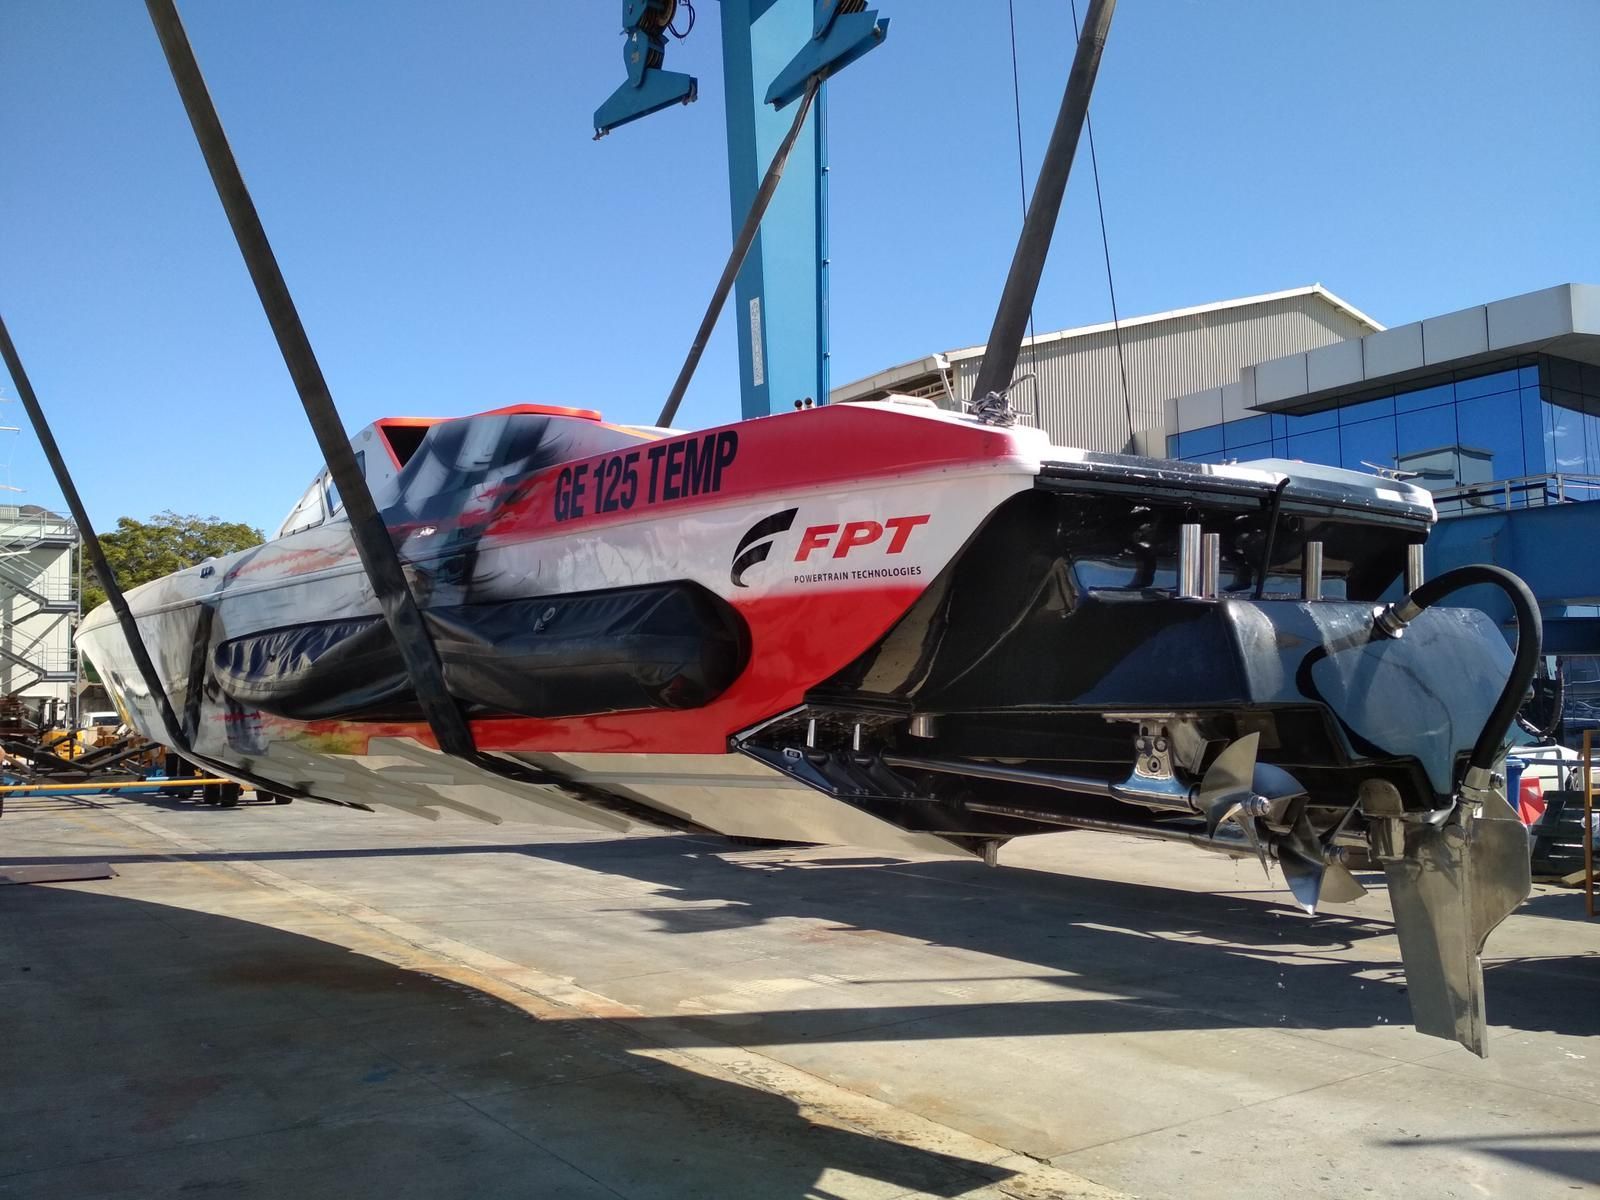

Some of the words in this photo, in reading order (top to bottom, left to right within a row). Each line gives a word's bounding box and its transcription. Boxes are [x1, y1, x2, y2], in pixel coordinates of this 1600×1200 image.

[554, 464, 588, 522] GE
[593, 452, 640, 514] 125
[648, 430, 738, 504] TEMP
[794, 514, 931, 562] FPT
[794, 571, 849, 583] POWERTRAIN
[852, 566, 922, 579] TECHNOLOGIES
